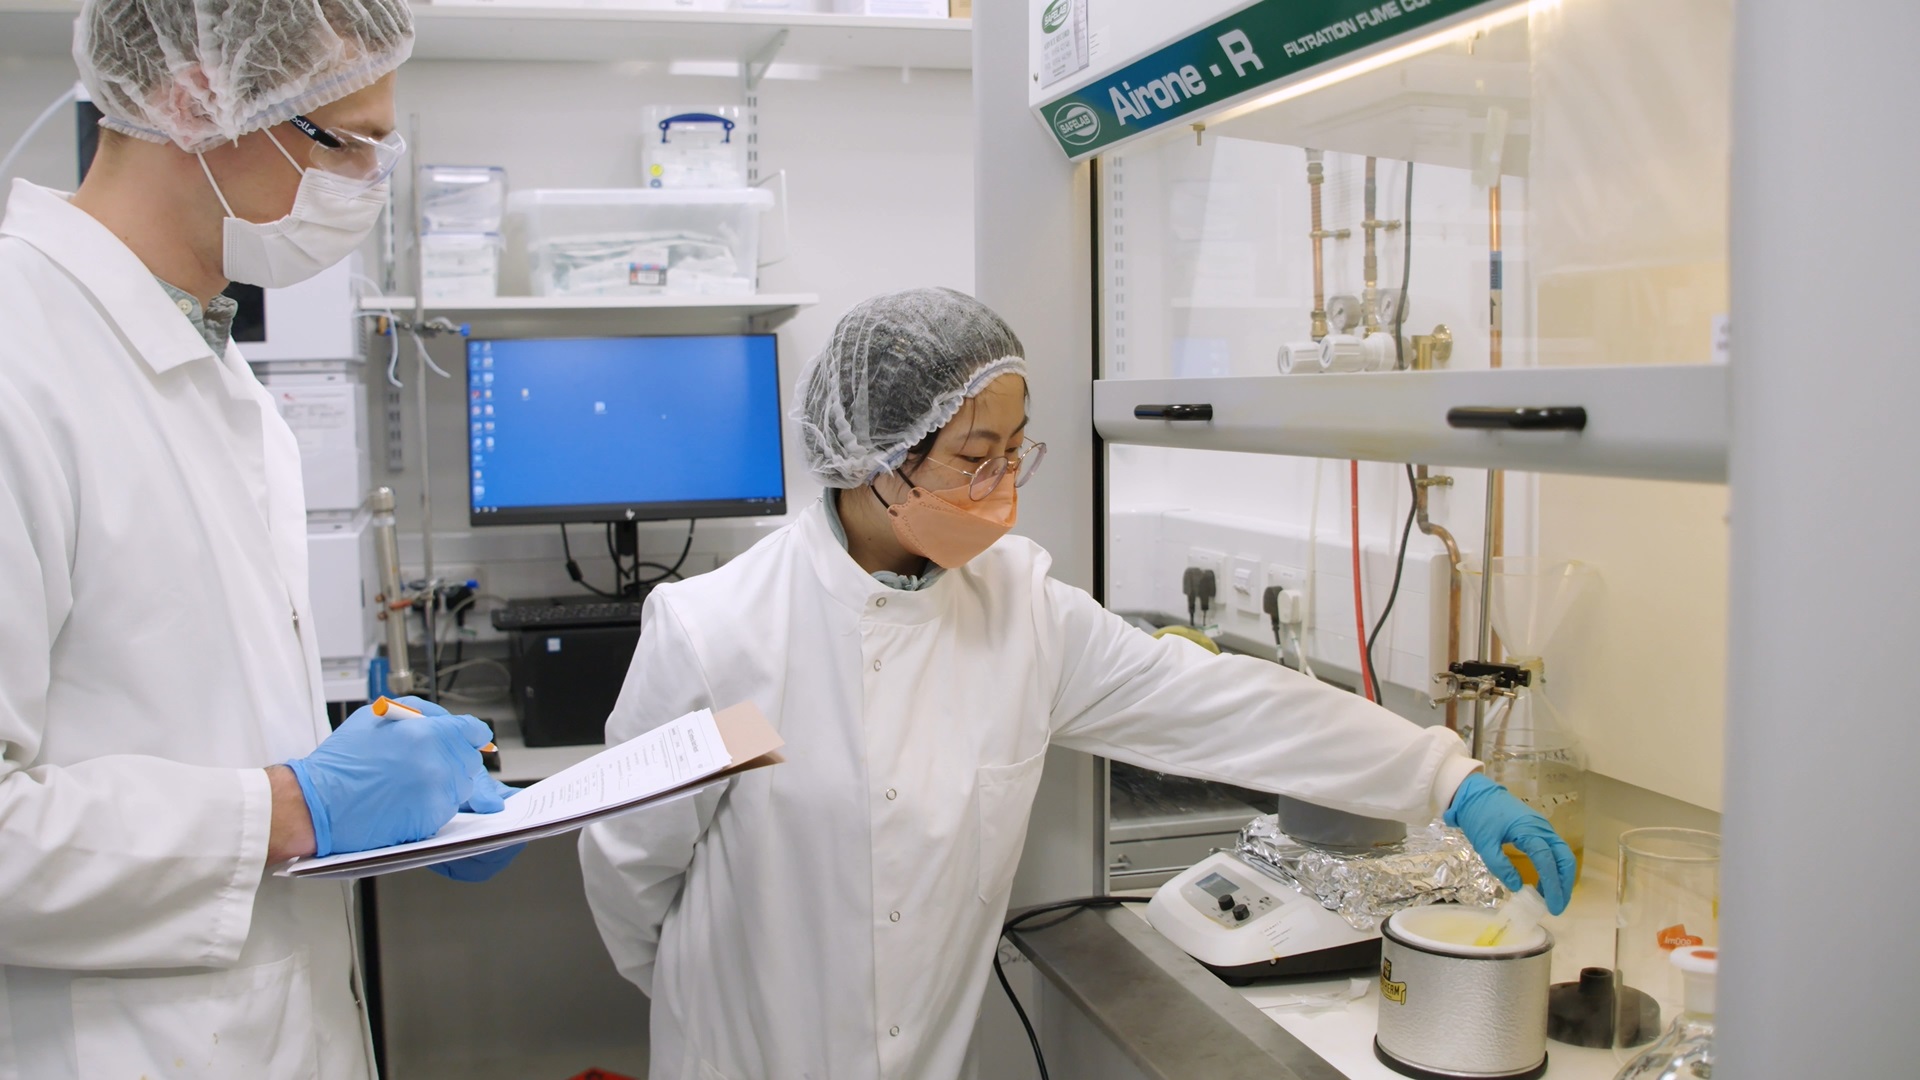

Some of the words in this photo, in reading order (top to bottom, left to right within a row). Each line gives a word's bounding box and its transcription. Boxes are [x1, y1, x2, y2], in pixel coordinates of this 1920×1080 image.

[1044, 3, 1067, 26] SAFELAB
[1283, 18, 1358, 58] FILTRATION
[1355, 0, 1402, 30] FUME
[1108, 65, 1207, 126] Airone
[1059, 114, 1091, 133] SAFELAB
